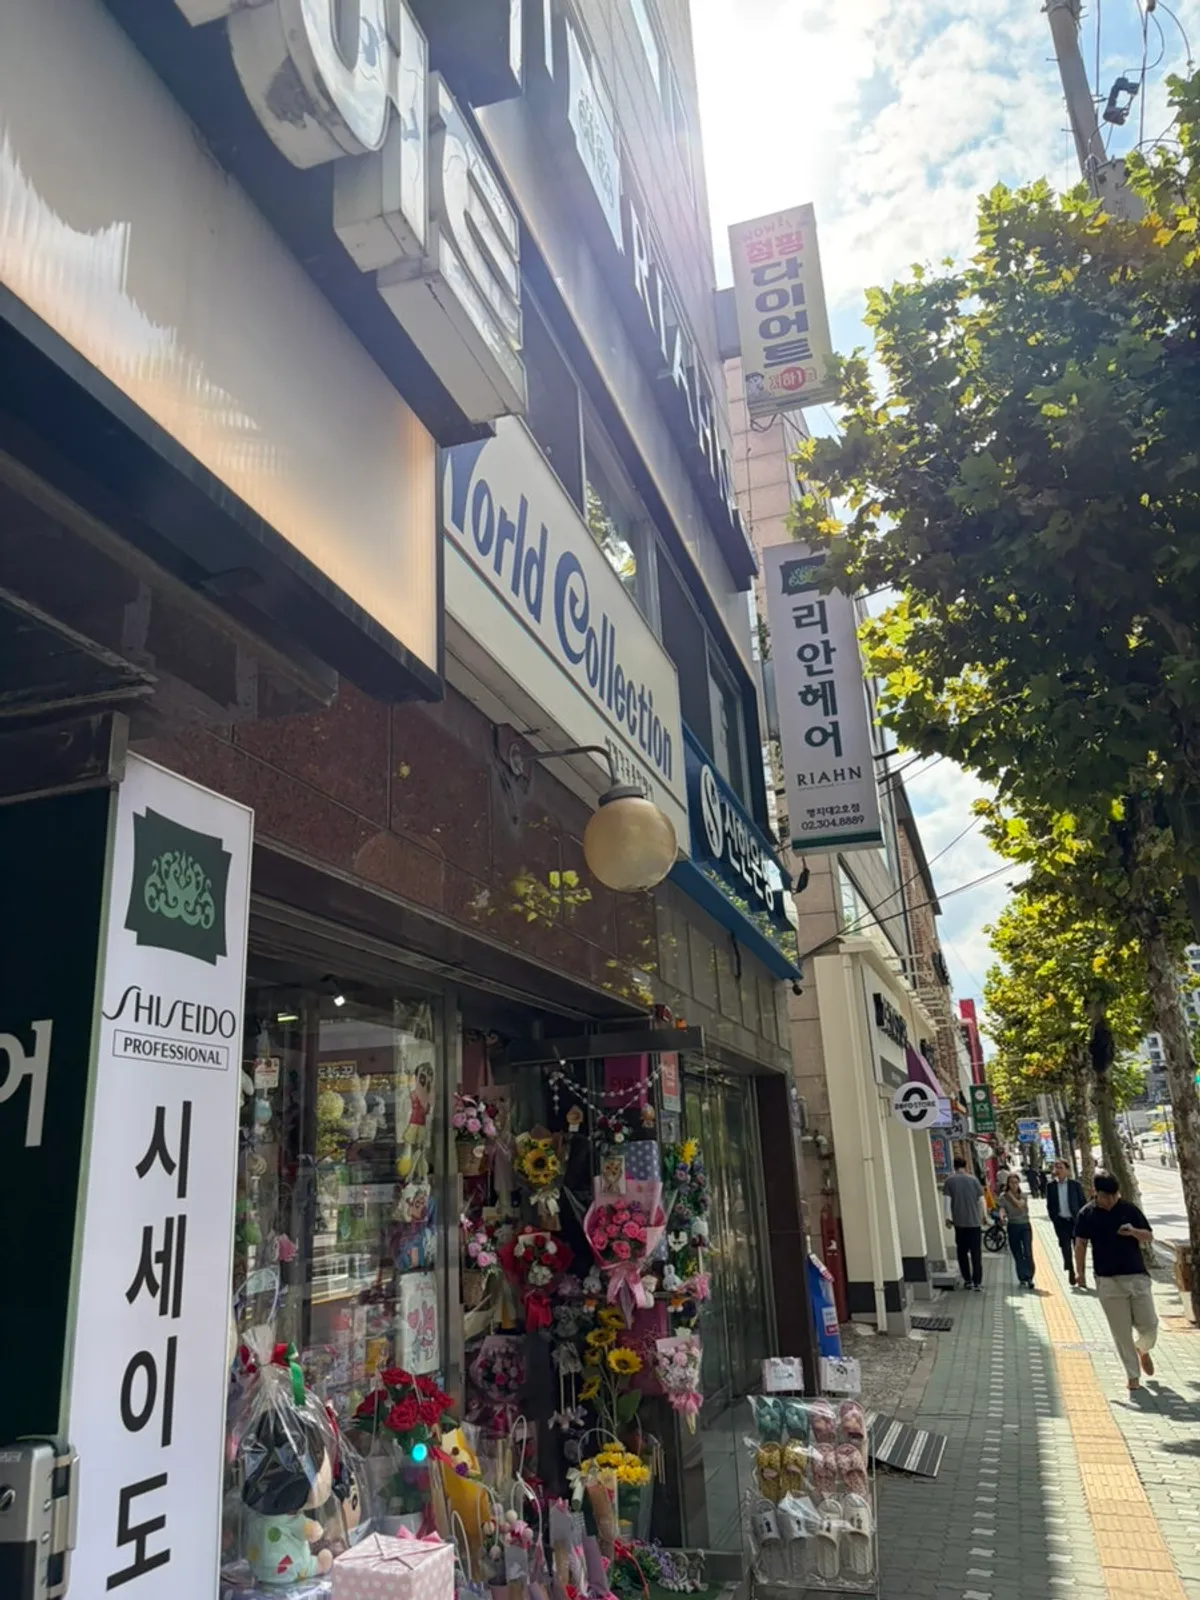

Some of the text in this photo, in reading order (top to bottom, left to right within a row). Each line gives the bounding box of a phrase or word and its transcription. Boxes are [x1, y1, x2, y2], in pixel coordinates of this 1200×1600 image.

[750, 256, 813, 369] 다이어트
[554, 550, 673, 782] Collection
[792, 599, 843, 758] 리안헤어
[797, 765, 862, 786] RIAHN
[801, 814, 865, 831] 02.304.8889
[101, 985, 237, 1039] SHISEIDO
[122, 1036, 223, 1066] PROFESSIONAL
[105, 1100, 193, 1592] 시세이도
